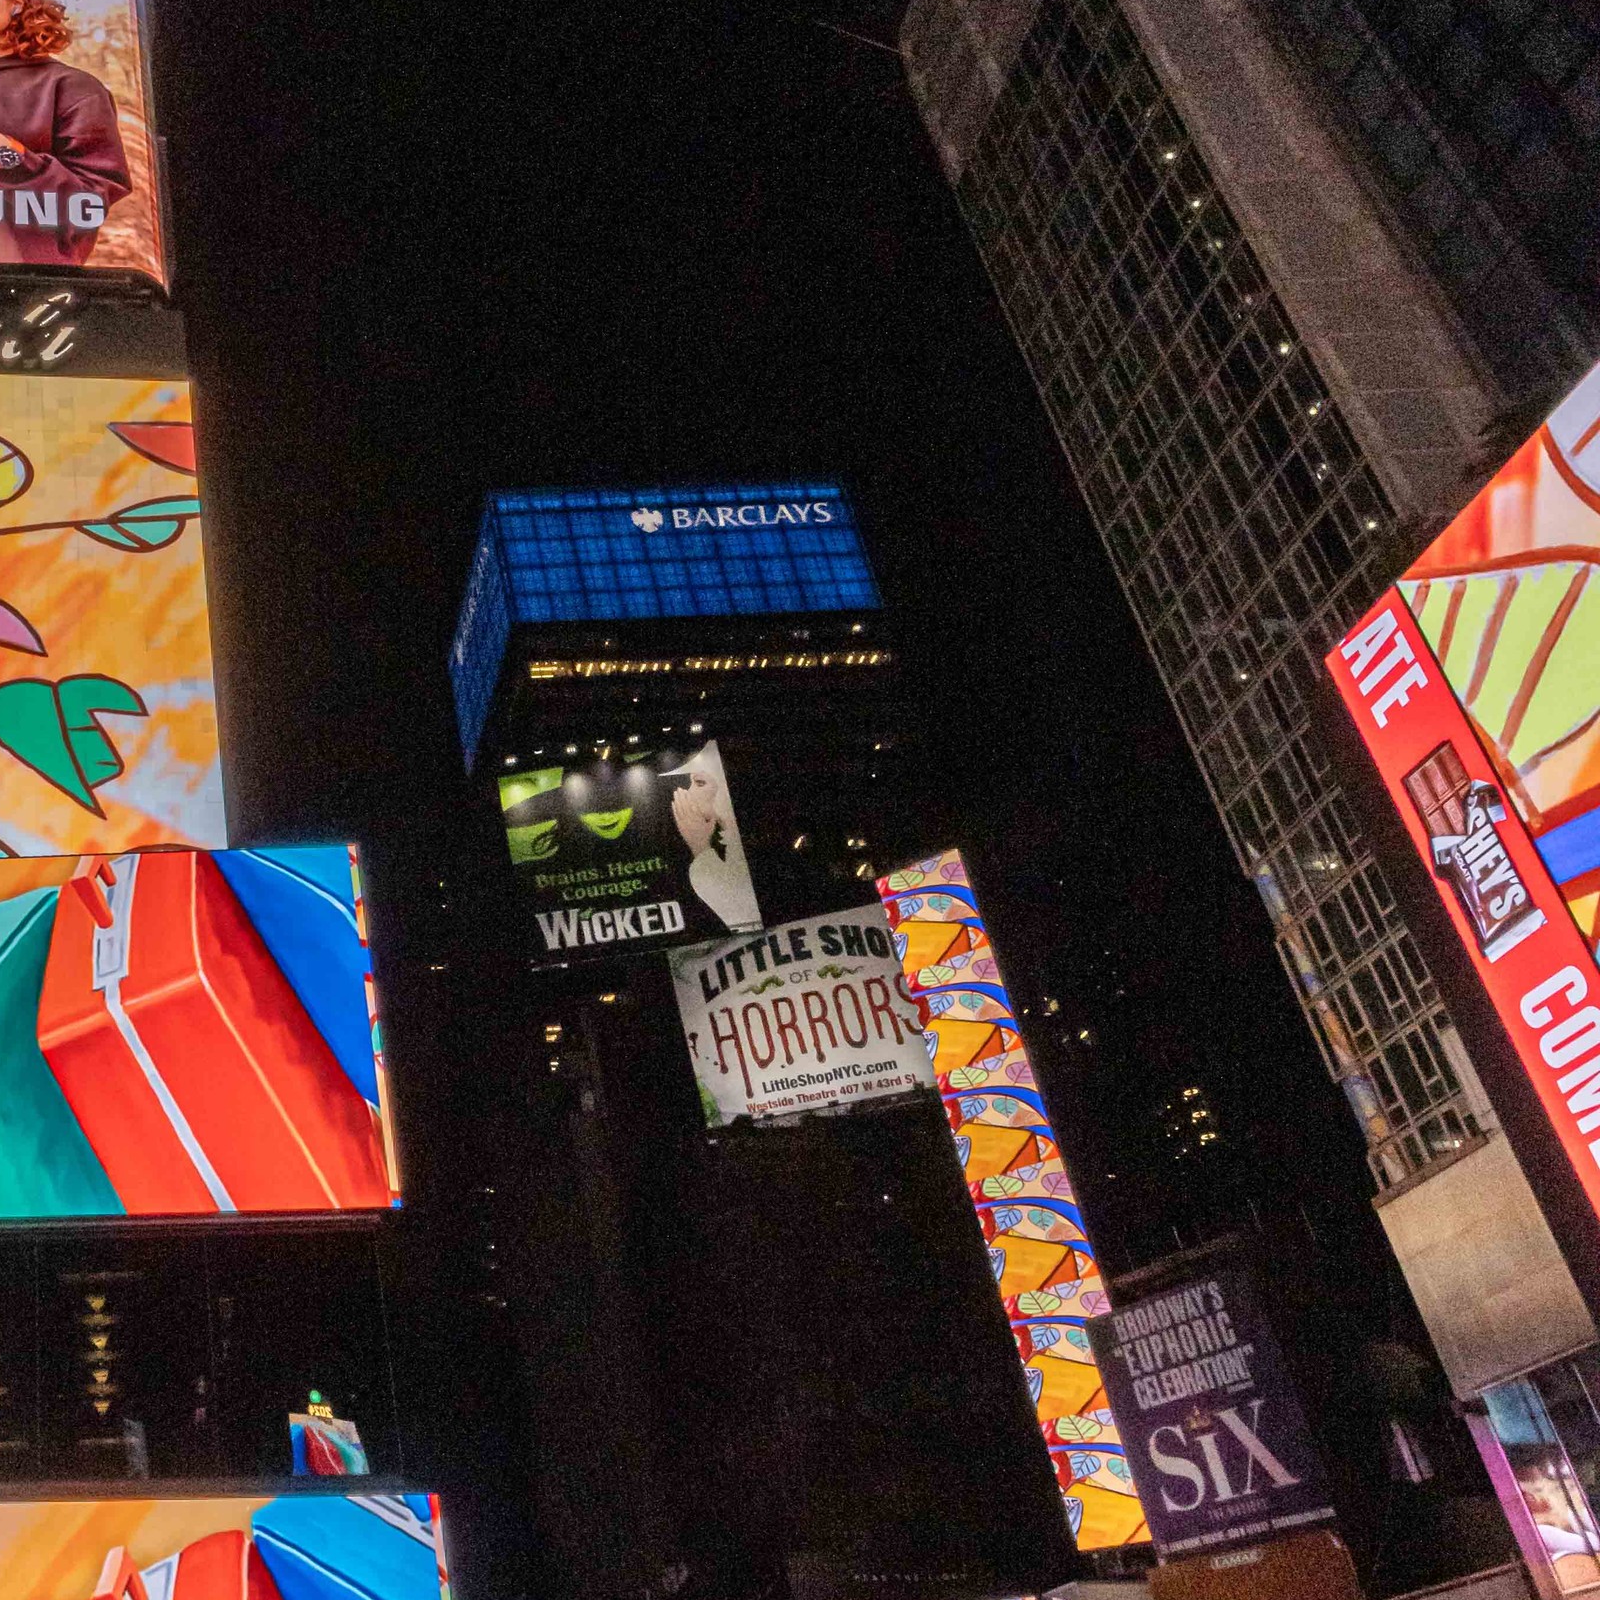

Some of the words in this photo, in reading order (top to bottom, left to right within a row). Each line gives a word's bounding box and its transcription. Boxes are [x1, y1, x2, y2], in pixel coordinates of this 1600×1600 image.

[672, 502, 832, 528] BARCLAYS
[1339, 608, 1429, 729] ATE
[535, 867, 604, 889] Brains.
[607, 857, 668, 877] Heart.
[562, 878, 648, 901] Courage.
[698, 927, 813, 1003] LITTLE
[789, 970, 812, 984] OF
[762, 1059, 898, 1094] LittleShopNYC.com
[1519, 965, 1600, 1170] COM
[746, 1096, 794, 1114] Westside
[796, 1089, 837, 1105] Theatre
[840, 1083, 860, 1095] 407
[862, 1080, 875, 1092] W
[876, 1075, 902, 1090] 43rd
[1113, 1281, 1224, 1342] BROADWAY'S
